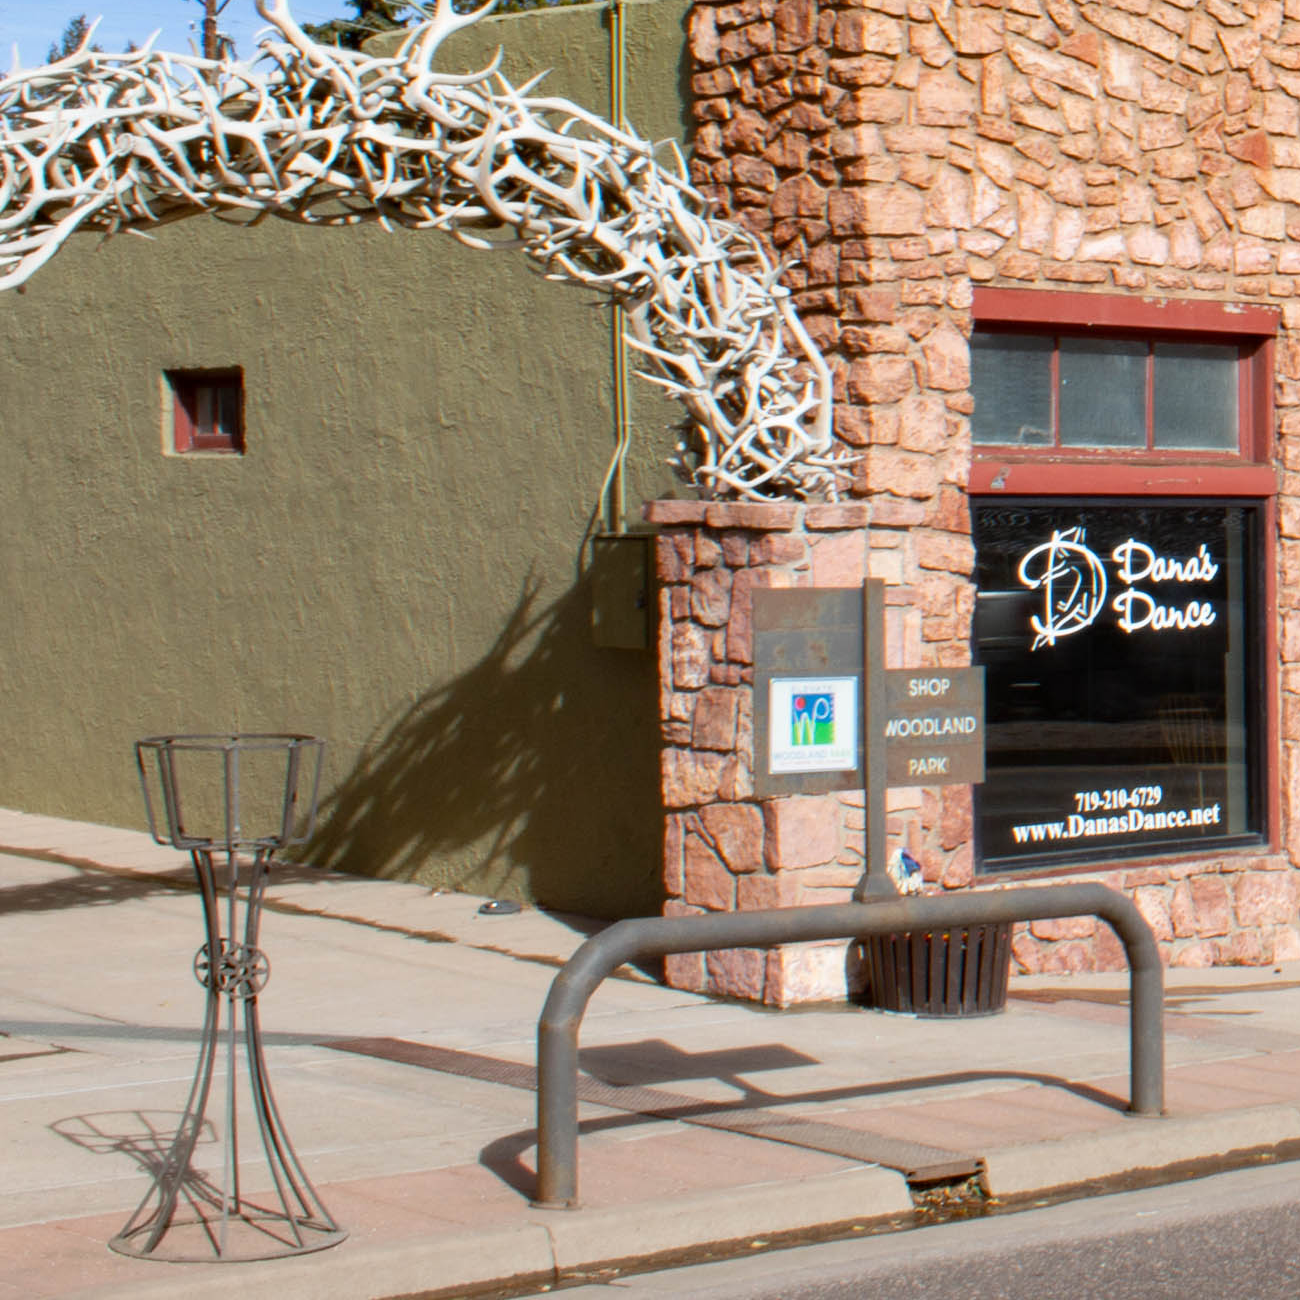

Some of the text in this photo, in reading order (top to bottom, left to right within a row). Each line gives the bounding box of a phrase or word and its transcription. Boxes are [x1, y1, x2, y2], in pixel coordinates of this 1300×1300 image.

[1111, 538, 1219, 584] Dana's
[1111, 586, 1217, 634] Dance
[908, 678, 951, 696] SHOP
[908, 757, 949, 776] PARK
[1074, 785, 1163, 813] 719-210-6729
[1011, 802, 1222, 844] www.DanasDance.net
